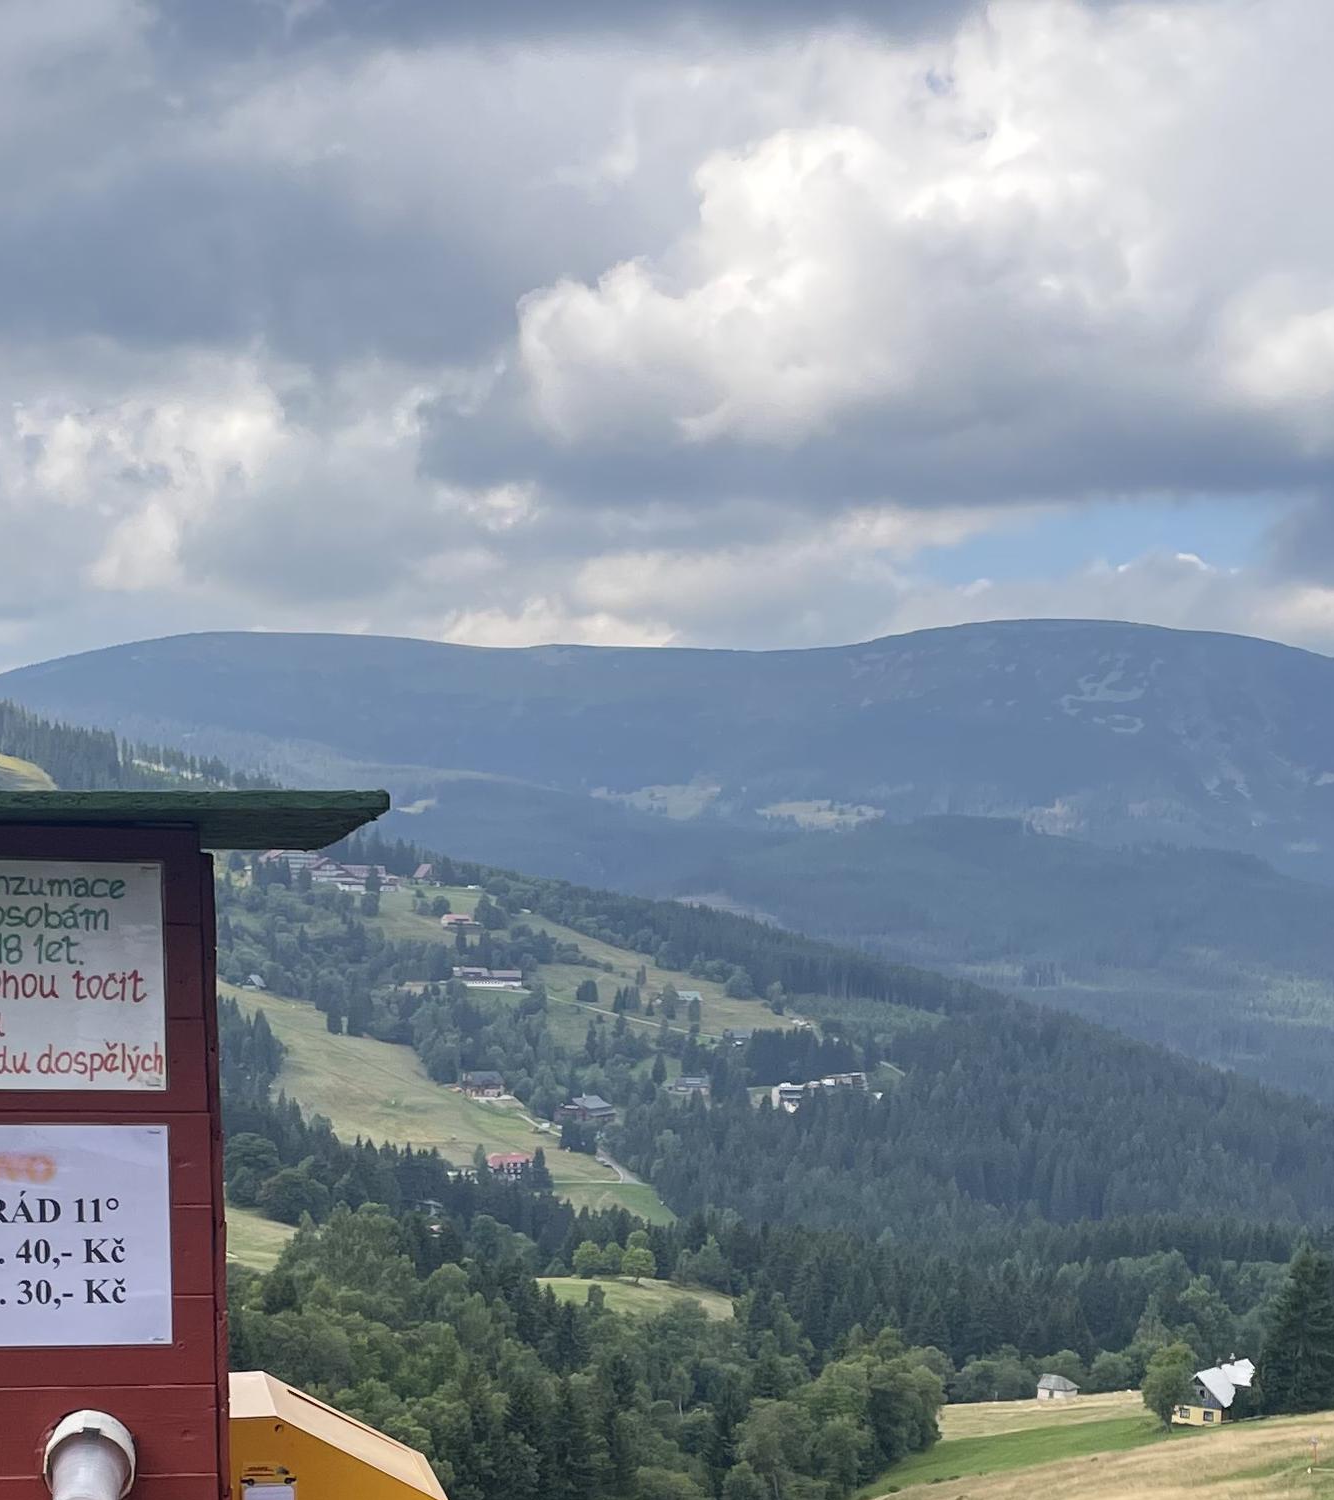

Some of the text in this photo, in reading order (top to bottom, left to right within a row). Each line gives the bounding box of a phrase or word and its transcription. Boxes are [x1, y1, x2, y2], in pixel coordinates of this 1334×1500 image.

[33, 934, 85, 965] let.
[72, 969, 148, 1003] točit
[37, 1041, 164, 1082] dospělých
[74, 1197, 120, 1223] 11°
[15, 1238, 73, 1270] 40,-
[82, 1237, 126, 1264] Kč
[16, 1279, 74, 1310] 30,-
[83, 1277, 127, 1304] Kč
